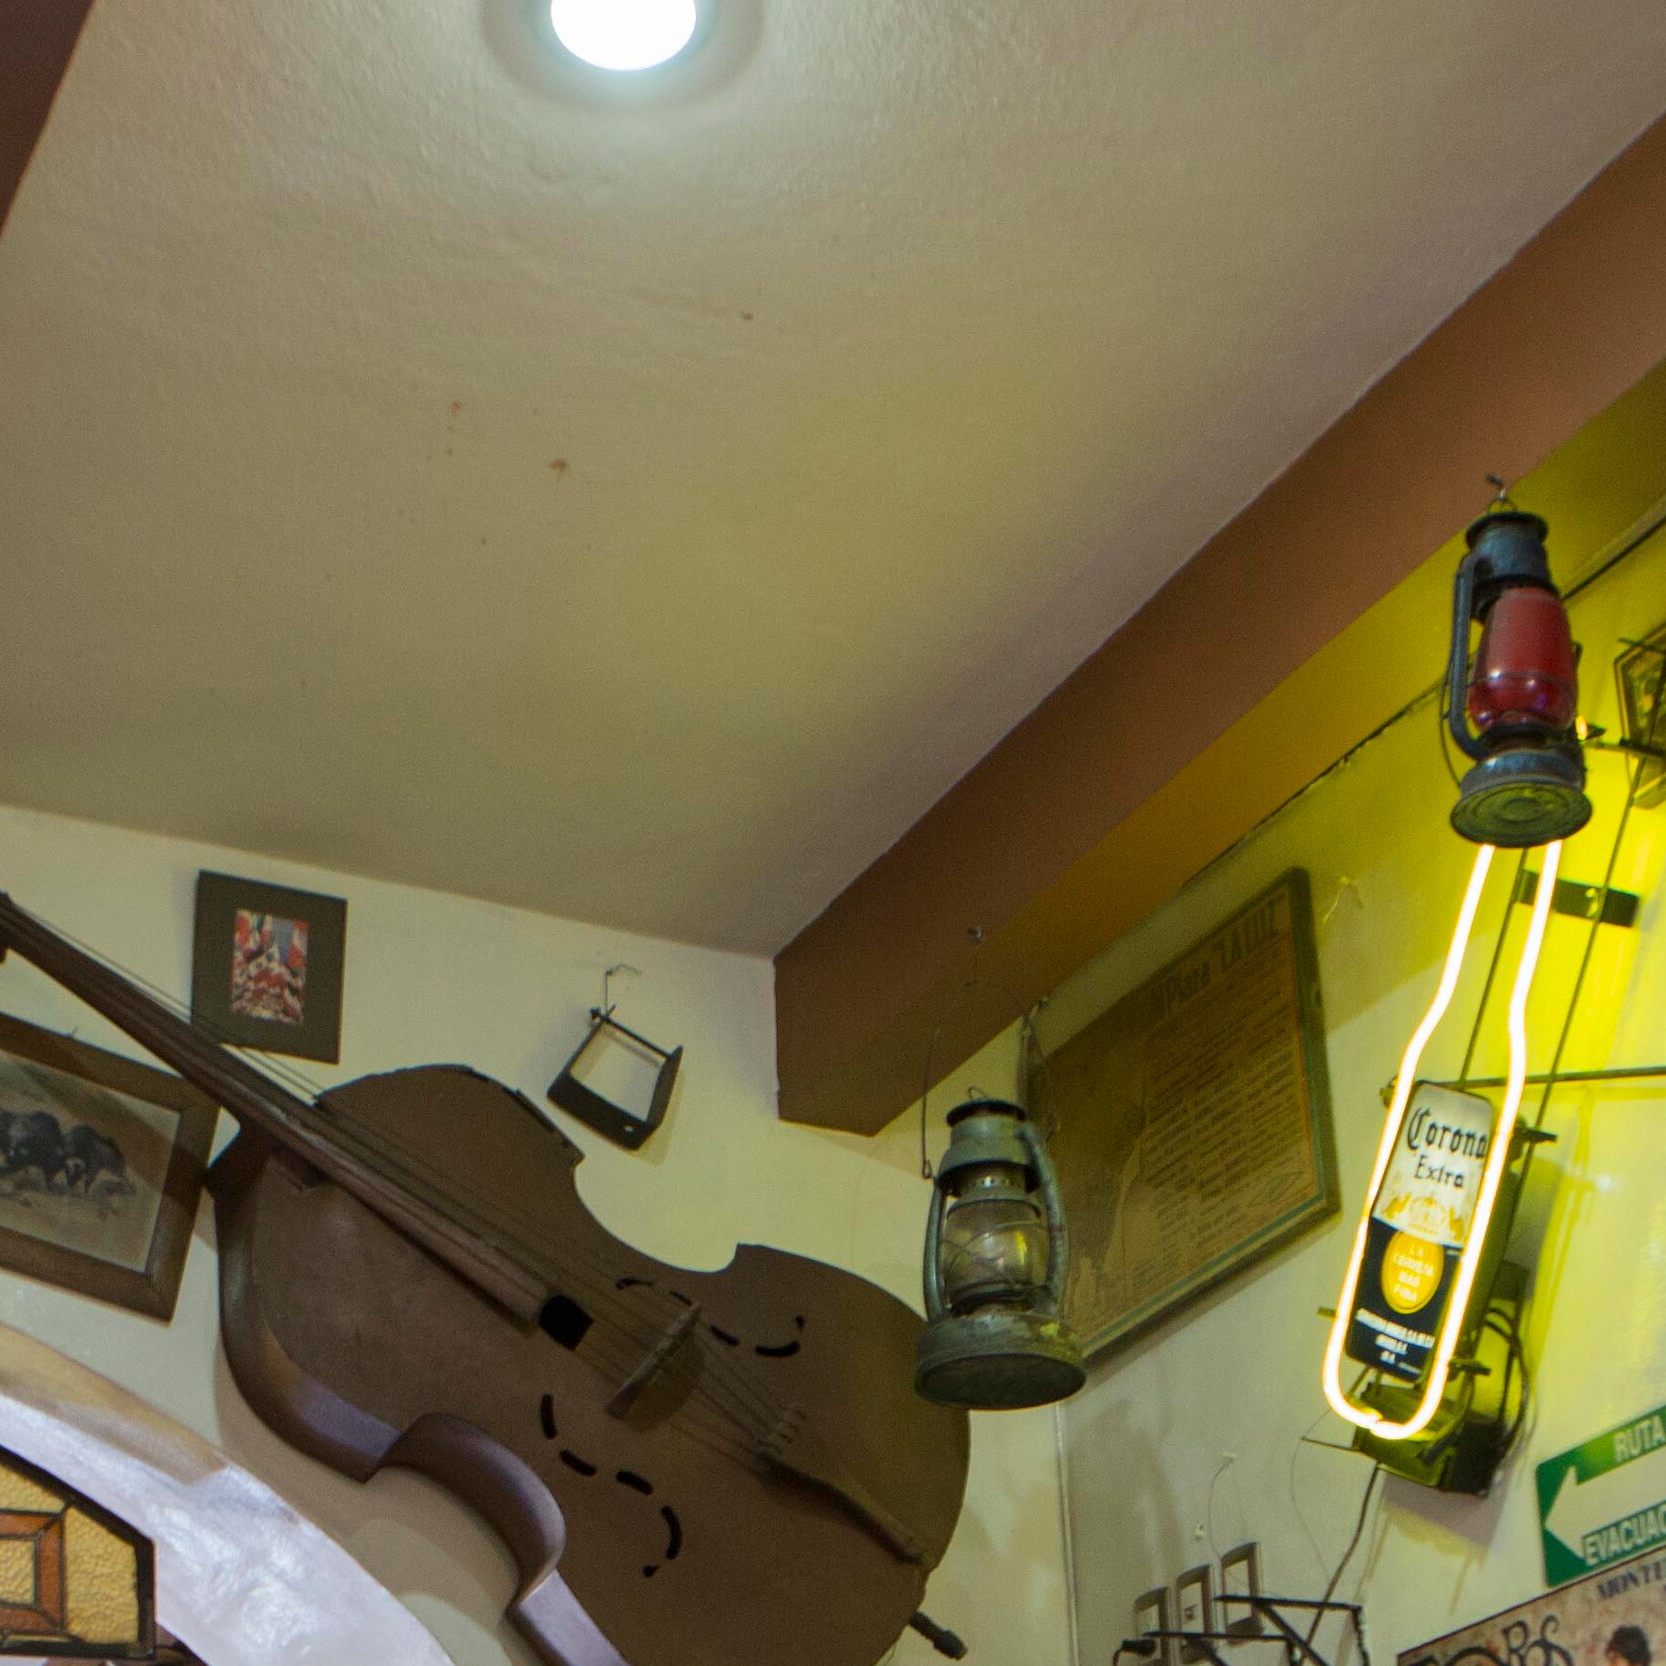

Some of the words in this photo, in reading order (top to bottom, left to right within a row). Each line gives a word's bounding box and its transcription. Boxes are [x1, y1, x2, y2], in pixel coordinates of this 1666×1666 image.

[1408, 1106, 1487, 1158] Corona
[1414, 1154, 1464, 1187] Extra
[1614, 1414, 1666, 1464] RUTA
